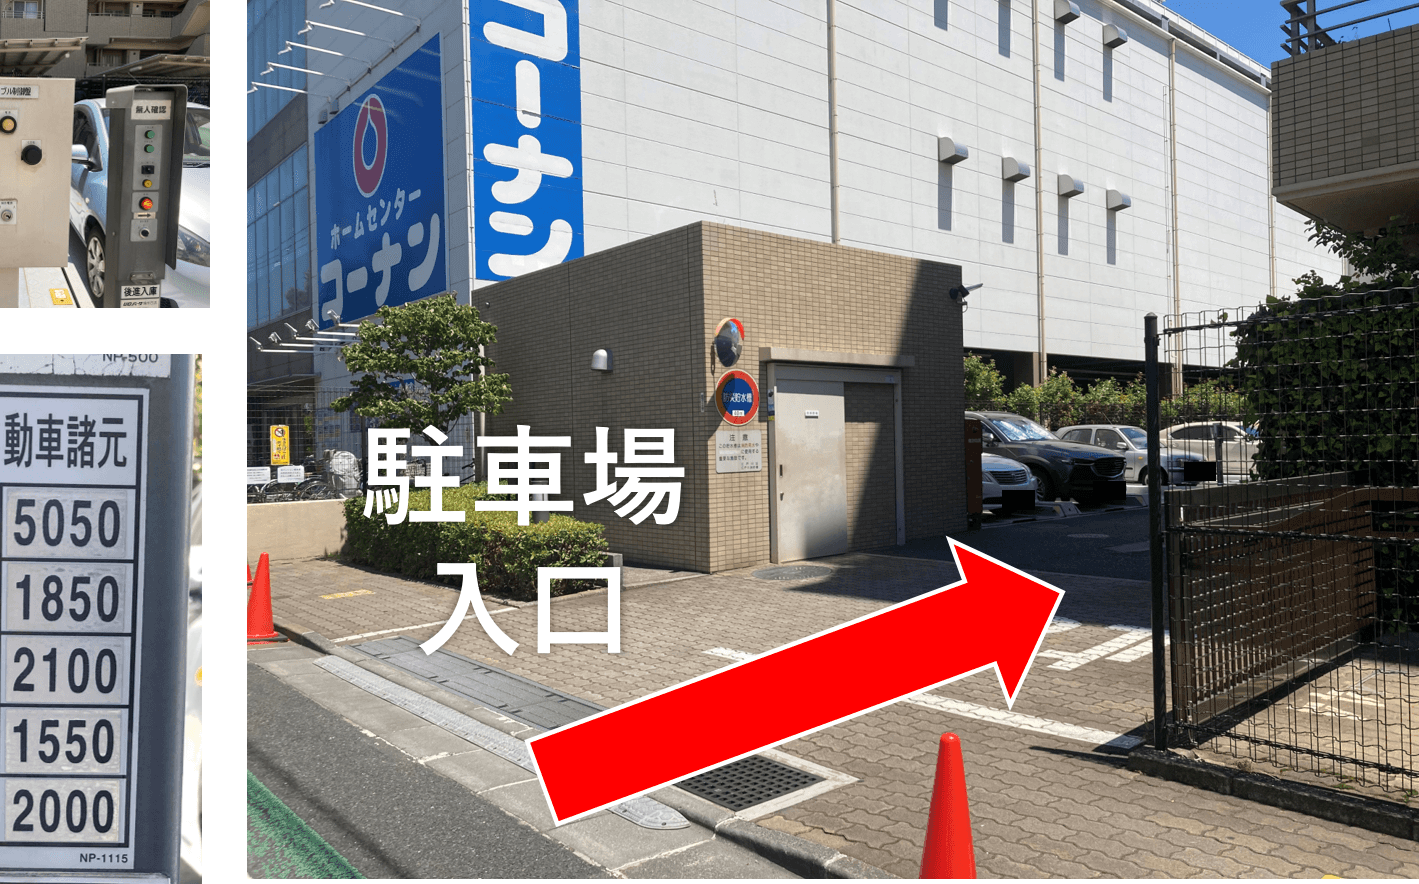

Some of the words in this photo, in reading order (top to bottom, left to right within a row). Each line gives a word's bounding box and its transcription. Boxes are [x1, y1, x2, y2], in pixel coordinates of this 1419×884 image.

[135, 105, 167, 114] 無人確認
[482, 0, 574, 278] コーナン
[330, 188, 421, 250] ホームセンター
[320, 212, 440, 322] コーナン
[123, 286, 158, 297] 後進入庫
[102, 353, 159, 363] NP-500
[14, 498, 121, 548] 5050
[15, 574, 120, 623] 1850
[13, 646, 118, 694] 2100
[13, 718, 115, 764] 1550
[12, 789, 114, 834] 2000
[79, 853, 129, 864] NP-1115
